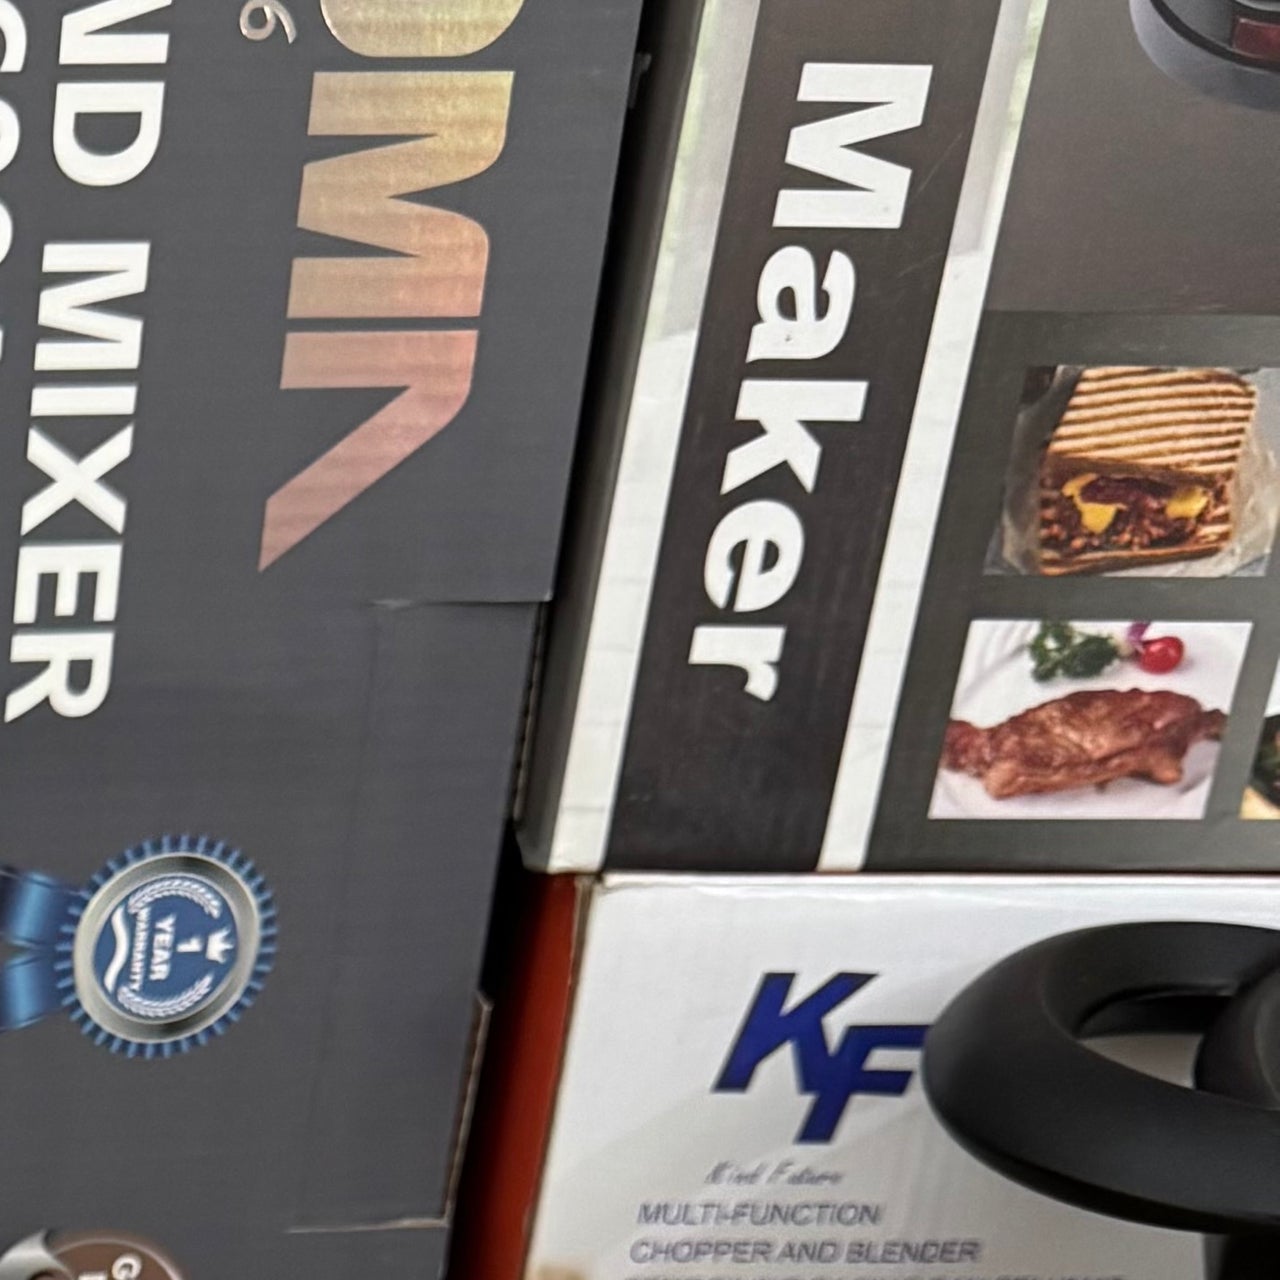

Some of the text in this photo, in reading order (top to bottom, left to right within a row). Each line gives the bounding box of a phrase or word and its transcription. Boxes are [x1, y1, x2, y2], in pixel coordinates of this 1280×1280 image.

[688, 62, 934, 702] Maker
[4, 241, 151, 723] MIXER
[149, 914, 177, 981] YEAR
[177, 936, 202, 953] 1
[711, 972, 933, 1145] KF
[637, 1202, 880, 1226] MULTI-FUNCTION
[629, 1240, 982, 1264] CHOPPER AND BLENDER
